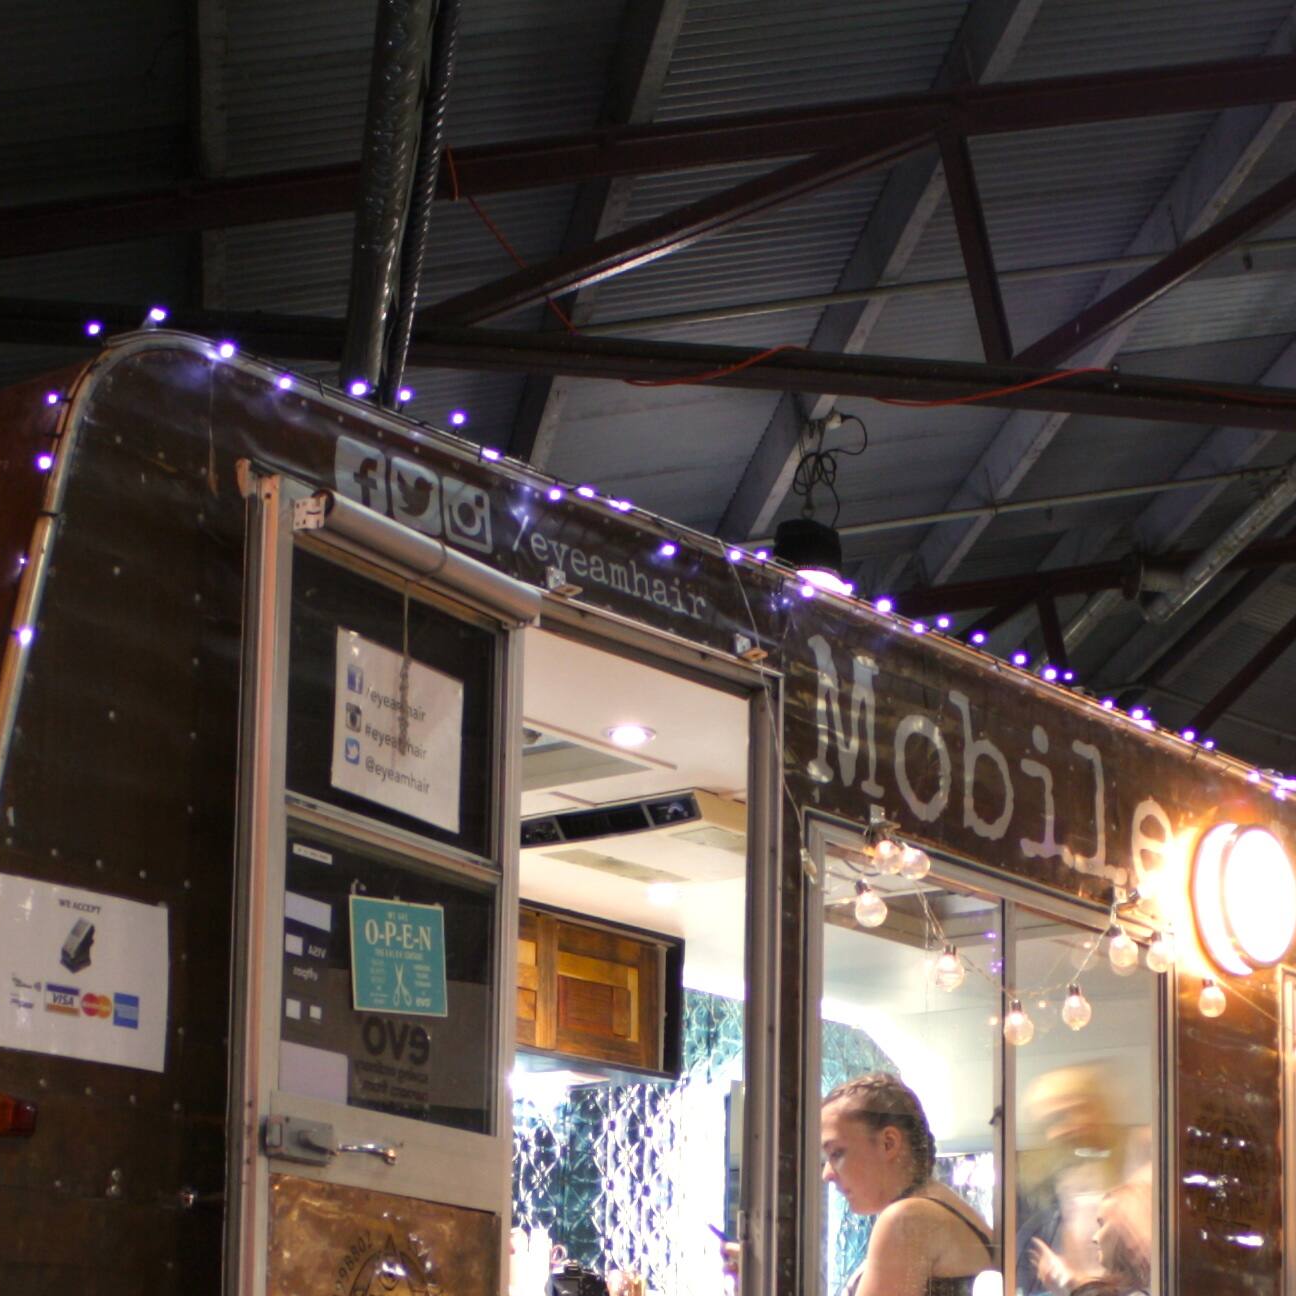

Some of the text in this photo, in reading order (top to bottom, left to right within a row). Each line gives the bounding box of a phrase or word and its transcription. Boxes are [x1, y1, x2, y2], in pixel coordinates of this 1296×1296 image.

[511, 514, 708, 621] /eyeamhair
[365, 723, 427, 760] #eyeahair
[807, 634, 1176, 880] Mobile
[365, 756, 430, 794] @eyeamhair
[58, 898, 101, 915] WE ACCEPT
[365, 918, 431, 952] O-P-E-N
[52, 993, 75, 1007] VISA
